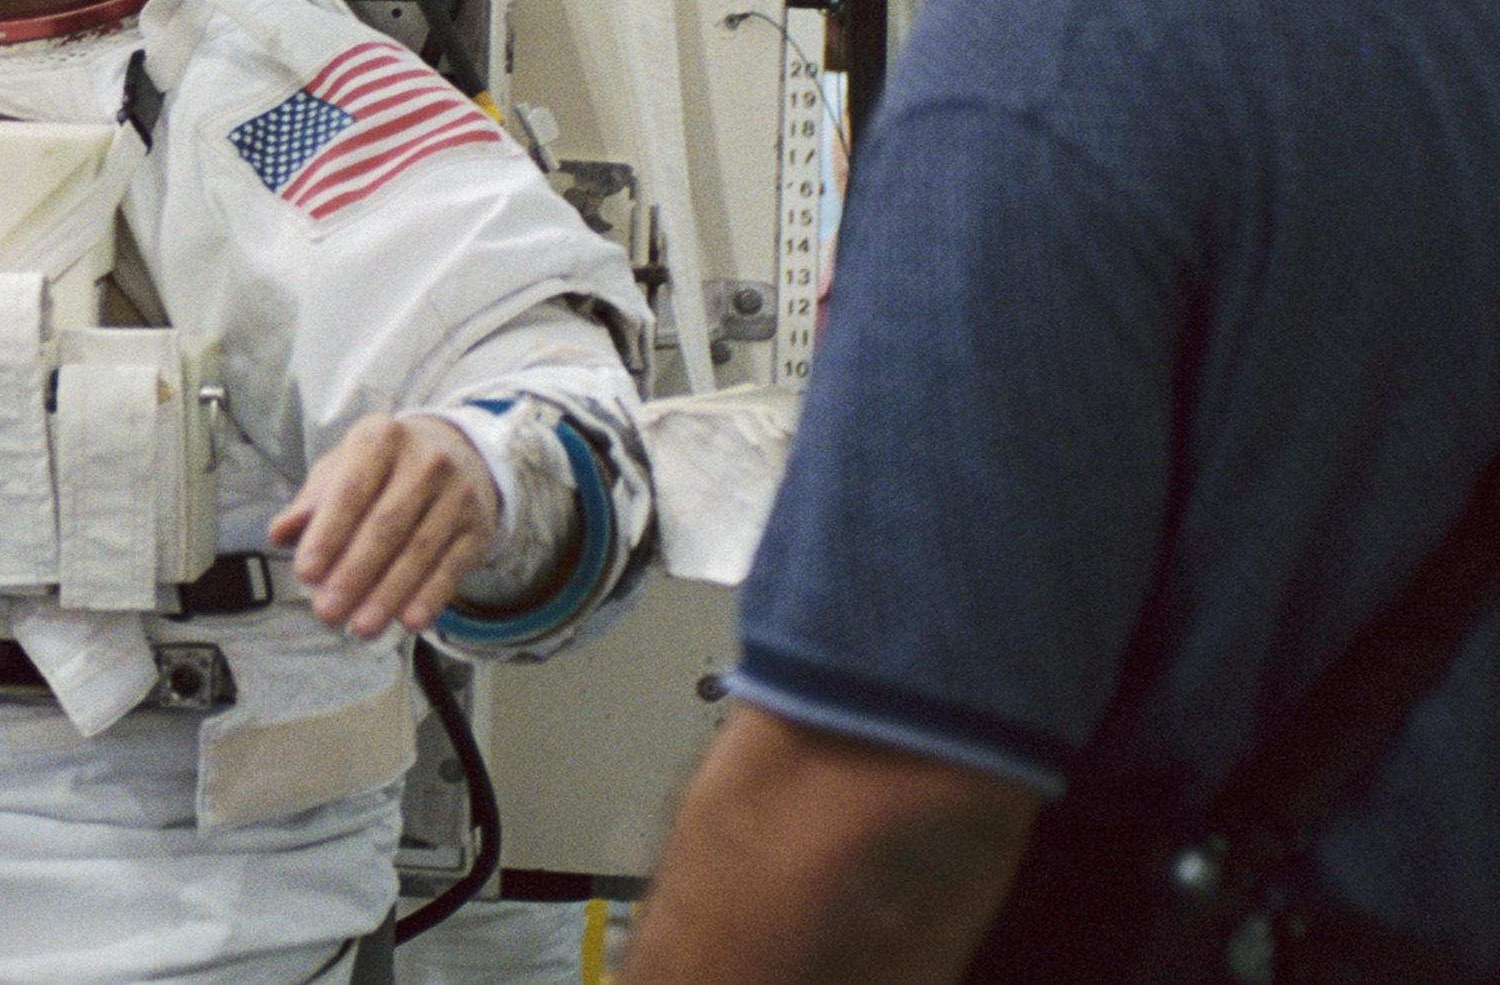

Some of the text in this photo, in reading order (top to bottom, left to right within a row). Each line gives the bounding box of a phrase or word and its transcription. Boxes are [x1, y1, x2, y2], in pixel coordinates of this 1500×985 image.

[789, 60, 818, 79] 20
[791, 91, 816, 109] 19
[790, 120, 815, 137] 18
[787, 209, 813, 226] 15
[785, 237, 810, 255] 14
[785, 267, 810, 285] 13
[786, 297, 810, 315] 12
[789, 329, 809, 346] 11
[784, 359, 810, 378] 10
